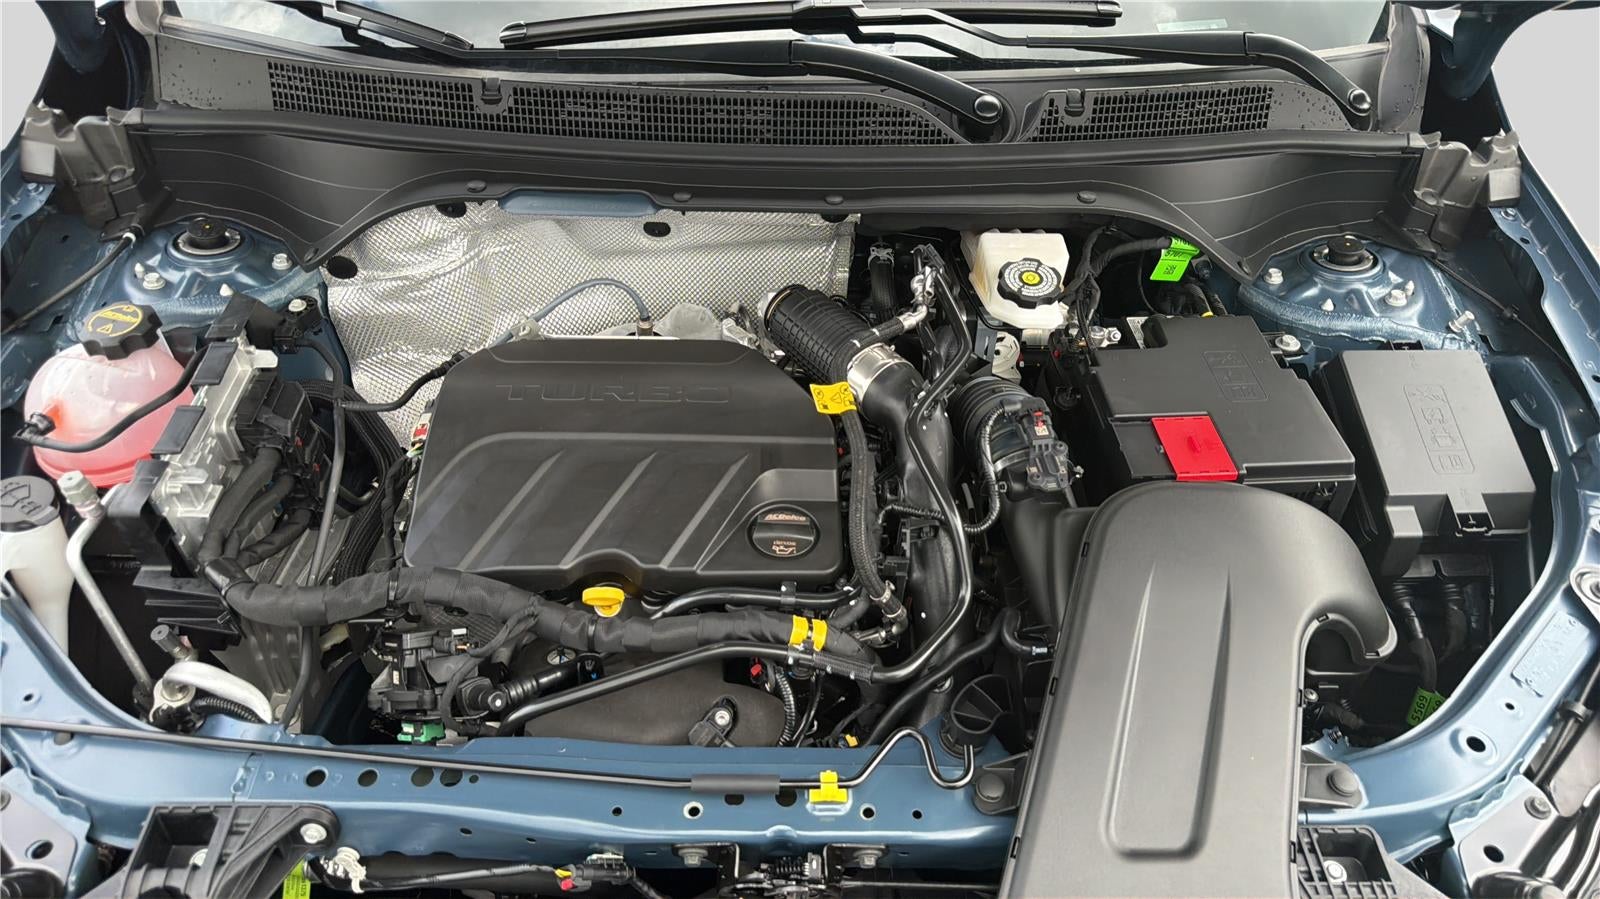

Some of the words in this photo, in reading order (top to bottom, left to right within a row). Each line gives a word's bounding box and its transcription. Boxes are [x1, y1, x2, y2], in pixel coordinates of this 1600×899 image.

[495, 382, 731, 403] TURBO
[764, 513, 806, 521] ACDelco
[1411, 695, 1427, 721] 5569
